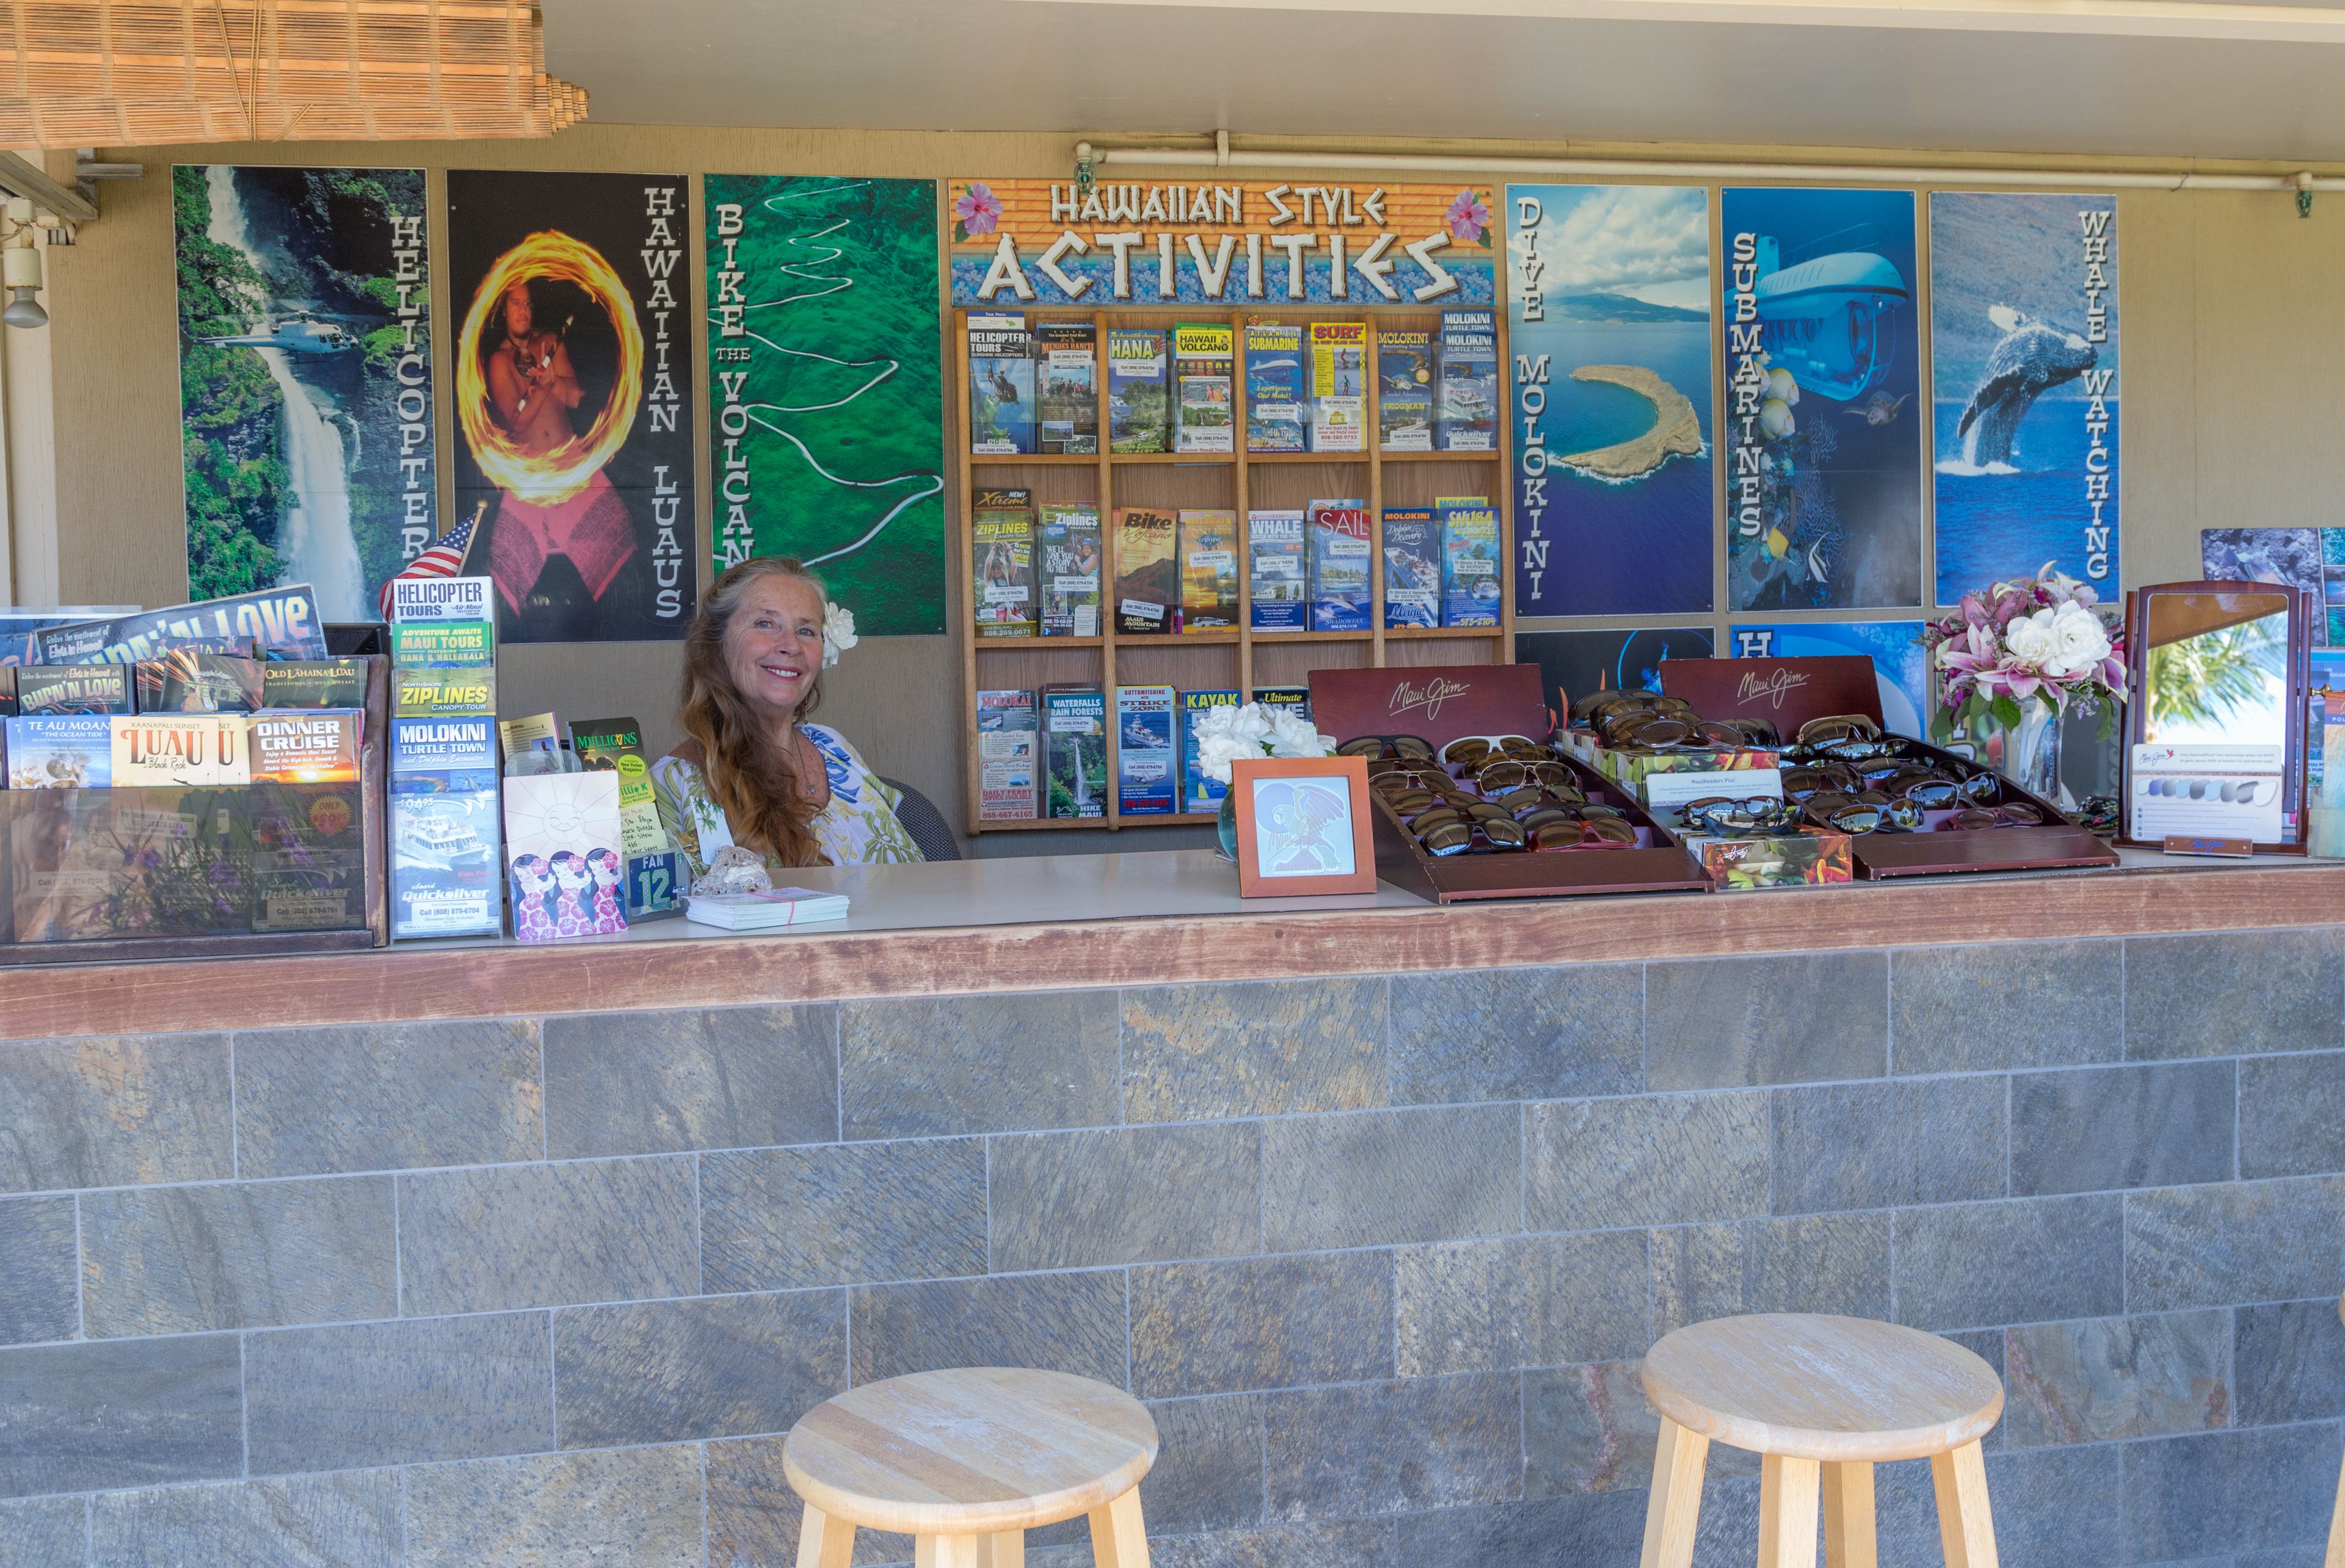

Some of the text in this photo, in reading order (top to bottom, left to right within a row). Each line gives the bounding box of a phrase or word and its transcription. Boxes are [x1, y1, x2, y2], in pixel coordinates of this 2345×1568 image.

[1050, 183, 1387, 225] HAWAIIAN STYLE
[716, 203, 746, 338] BIKE
[977, 230, 1461, 302] ACTIVITIES
[1444, 313, 1490, 324] MOLOKINI
[970, 332, 1025, 343] HELICOPTER
[1314, 325, 1364, 339] SURF
[1378, 333, 1429, 344] MOLOKINI
[970, 343, 1002, 352] TOURS
[1180, 343, 1229, 352] VOLCANO
[1249, 338, 1299, 350] SUBMARINE
[1446, 335, 1492, 346] MOLOKINI
[716, 347, 751, 361] THE
[1041, 343, 1094, 354] MENDES RANCH
[1110, 339, 1154, 359] HANA
[390, 215, 428, 562] HELICOPTER
[1730, 231, 1764, 537] SUBMARINES
[1516, 196, 1552, 601] DIVE MOLOKINI
[2078, 210, 2112, 580] WHALE WATCHING
[641, 187, 684, 619] HAWAIIAN LUAUS
[976, 492, 1028, 507] Xtreme
[1055, 513, 1098, 528] Ziplines
[1124, 512, 1172, 531] Bike
[1319, 512, 1369, 536] SAIL
[1448, 510, 1494, 528] SNUBA
[976, 523, 1028, 535] ZIPLINES
[1251, 520, 1301, 535] WHALE
[1387, 524, 1412, 535] Dolphin
[1118, 528, 1172, 545] Volcano
[1391, 532, 1422, 543] Discovery
[398, 582, 482, 604] HELICOPTER
[398, 604, 443, 617] TOURS
[214, 595, 311, 645] LOVE
[400, 635, 483, 650] MAUI TOURS
[436, 652, 485, 661] HALEAKALA
[266, 669, 286, 679] OLD
[84, 678, 122, 696] LOVE
[1737, 667, 1811, 710] Maui Jim
[400, 686, 487, 705] ZIPLINES
[981, 695, 1031, 706] MOLOKAI
[1187, 693, 1238, 708] KAYAK
[1265, 692, 1302, 703] Ultimate
[1389, 677, 1471, 720] Maui Jim
[1053, 699, 1101, 708] WATERFALLS
[1051, 707, 1103, 716] RAIN FORESTS
[28, 721, 43, 731] TE
[45, 721, 66, 730] AU
[257, 720, 341, 736] DINNER
[399, 723, 486, 743] MOLOKINI
[120, 729, 205, 766] LUAU
[260, 736, 340, 751] CRUISE
[401, 743, 486, 755] TURTLE TOWN
[418, 755, 448, 764] Dolphin
[642, 855, 664, 869] FAN
[261, 887, 352, 900] Quicksilver
[639, 868, 671, 905] 12
[401, 888, 490, 902] Quicksilver
